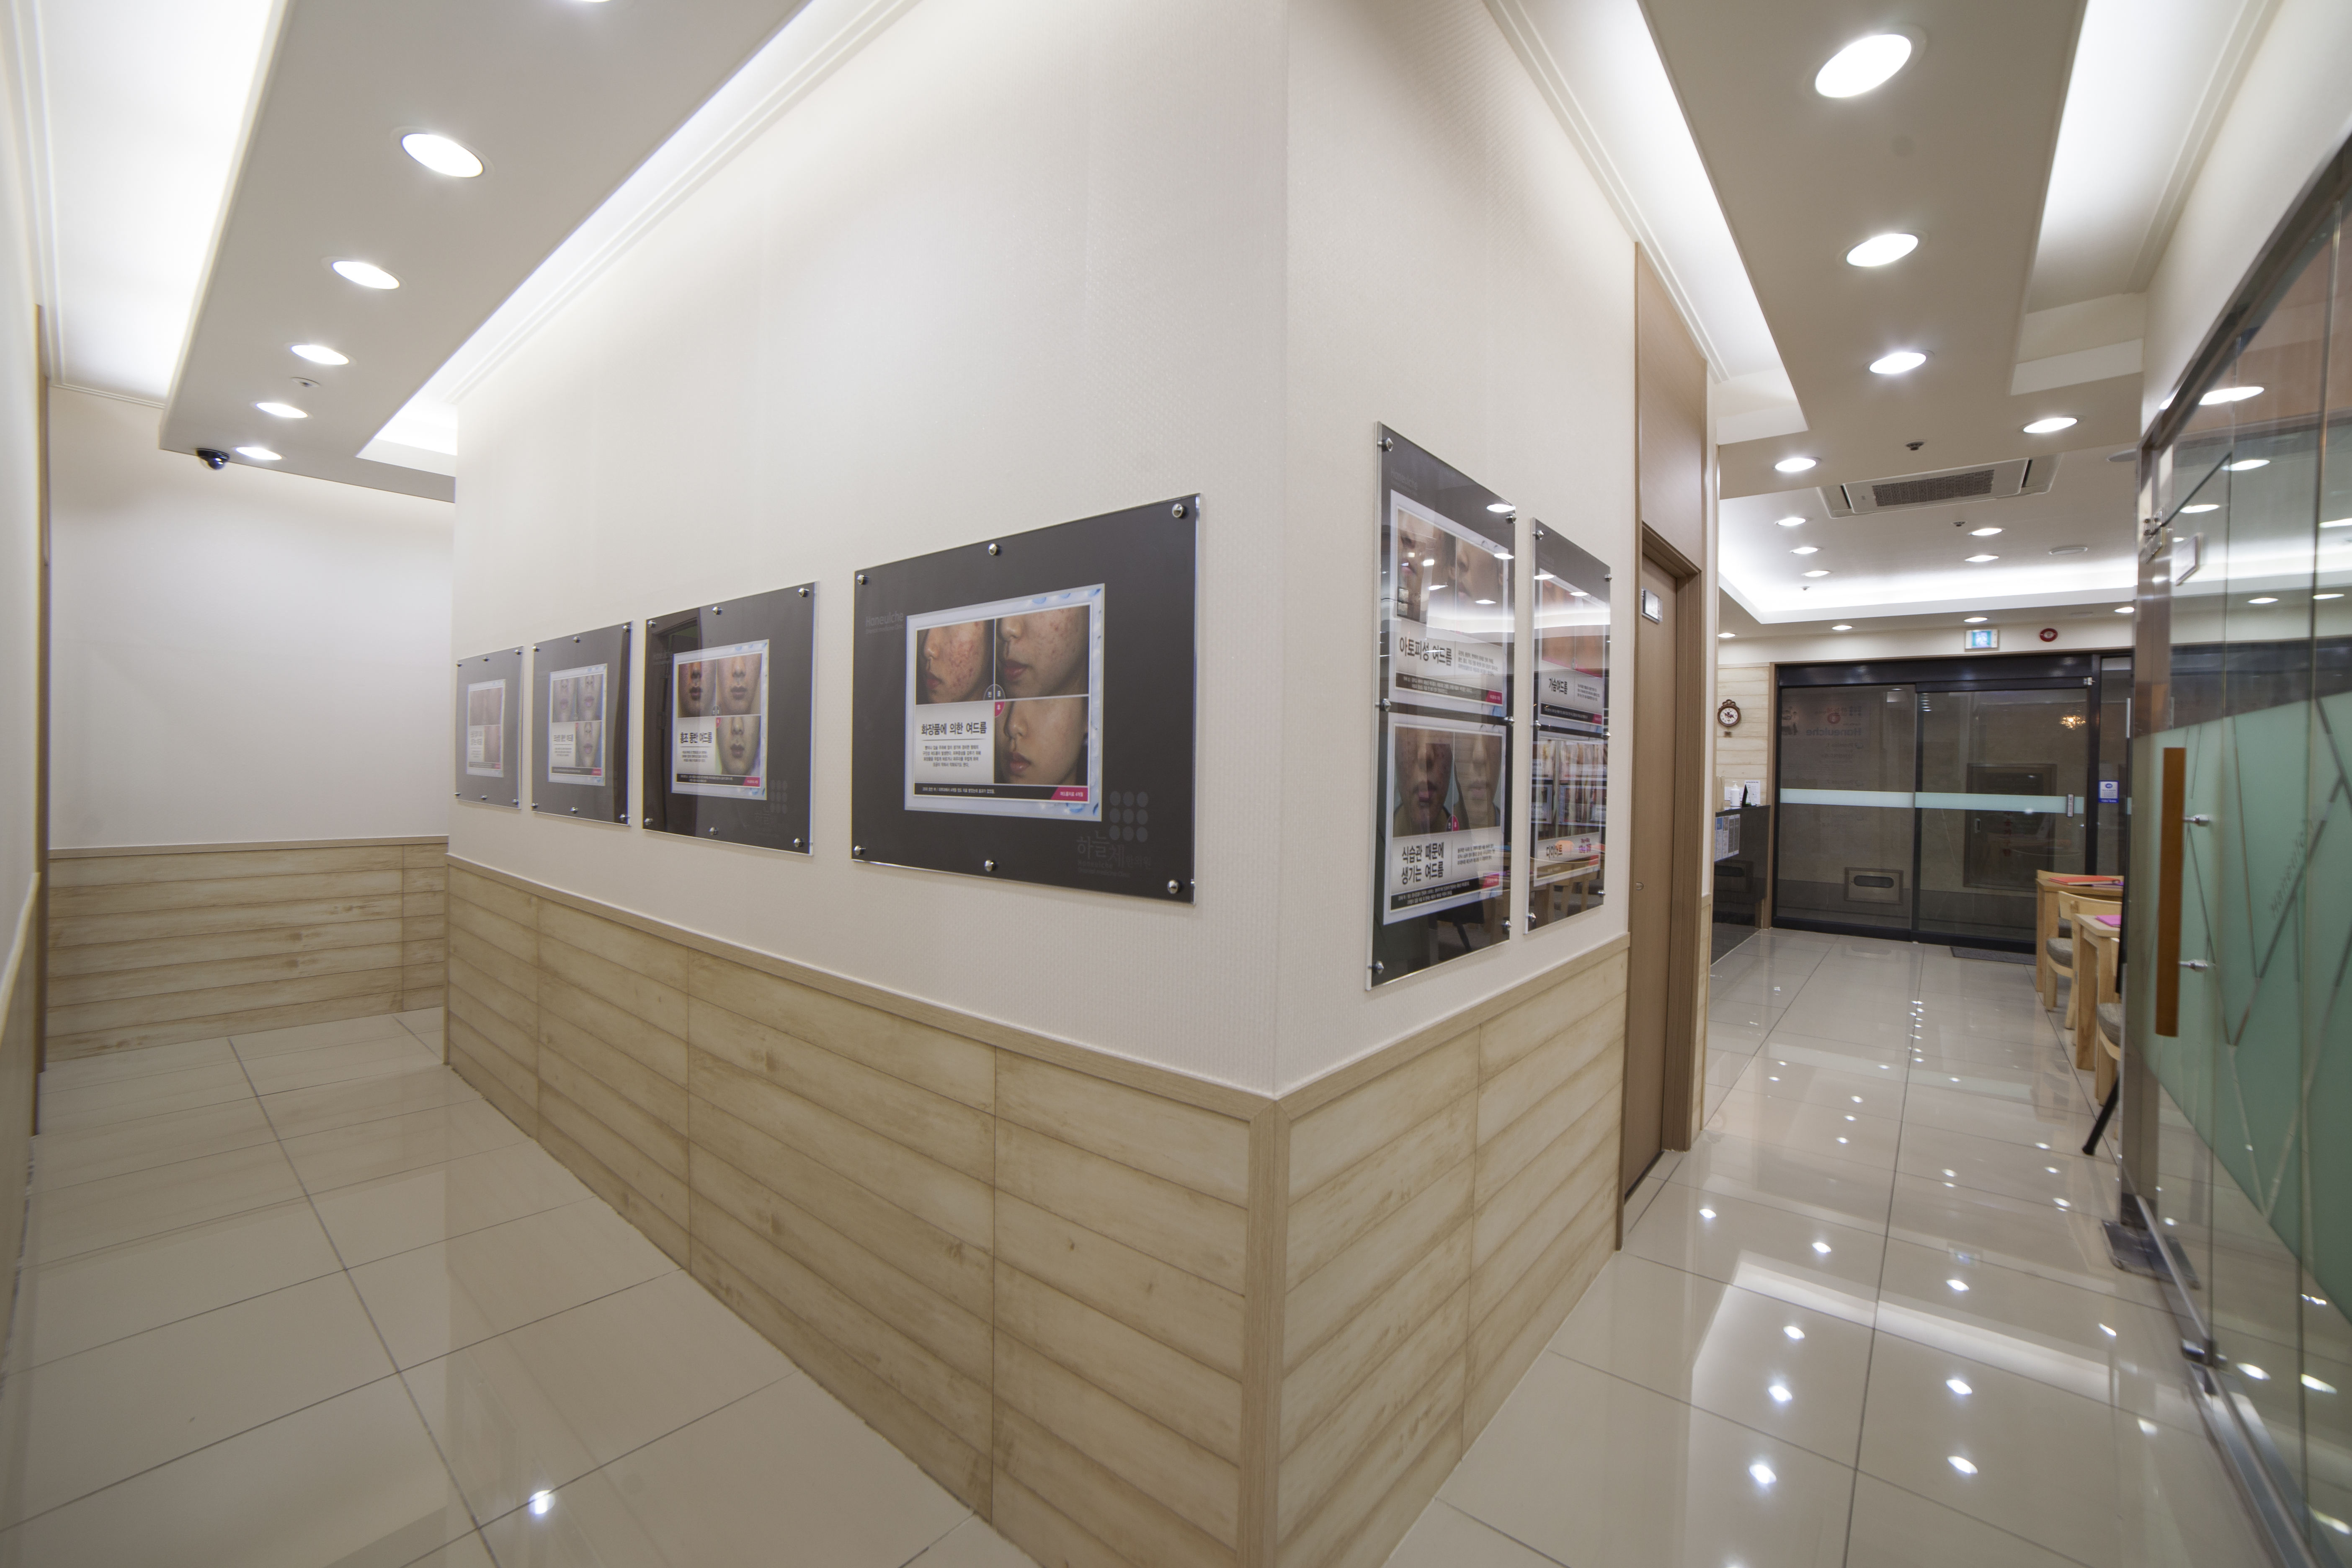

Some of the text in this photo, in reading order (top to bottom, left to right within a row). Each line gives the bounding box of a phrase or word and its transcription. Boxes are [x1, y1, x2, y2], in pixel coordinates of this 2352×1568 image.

[1399, 637, 1429, 661] 아토피성
[1432, 645, 1452, 666] 여드름
[1549, 677, 1568, 695] 가슴여드름
[921, 721, 987, 735] 화장품에 의한 여드름
[700, 732, 712, 743] 여드름
[1402, 844, 1422, 864] 식습관
[1425, 842, 1444, 860] 때문에
[1546, 843, 1563, 859] 다이어트
[1401, 861, 1444, 885] 생기는 여드름
